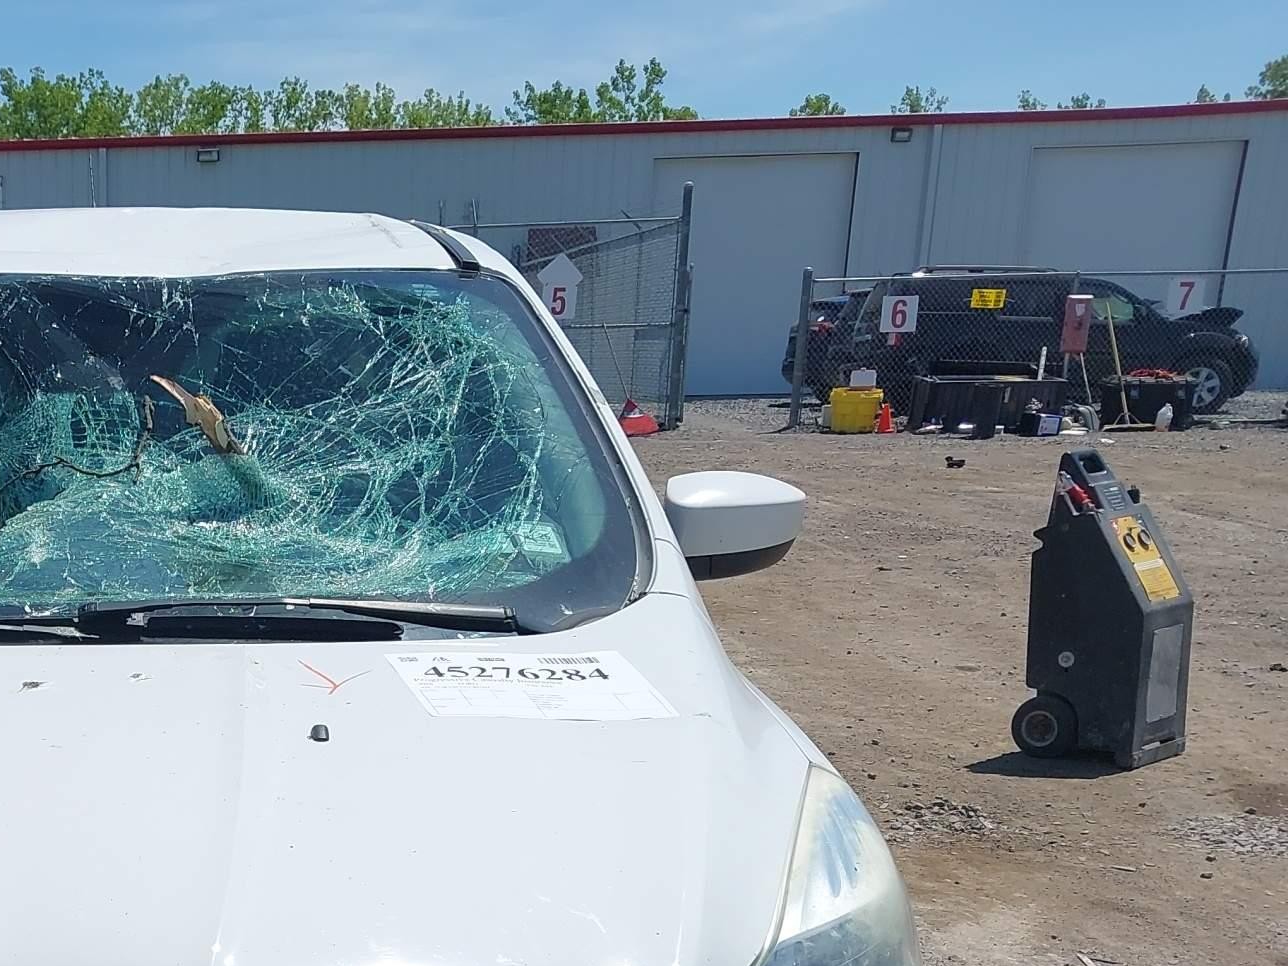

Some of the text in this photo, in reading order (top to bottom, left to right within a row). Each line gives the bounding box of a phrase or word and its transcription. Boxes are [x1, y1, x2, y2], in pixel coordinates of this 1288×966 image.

[551, 287, 567, 316] 5
[1179, 281, 1195, 310] 7
[891, 299, 908, 329] 6
[423, 665, 610, 682] 45276284
